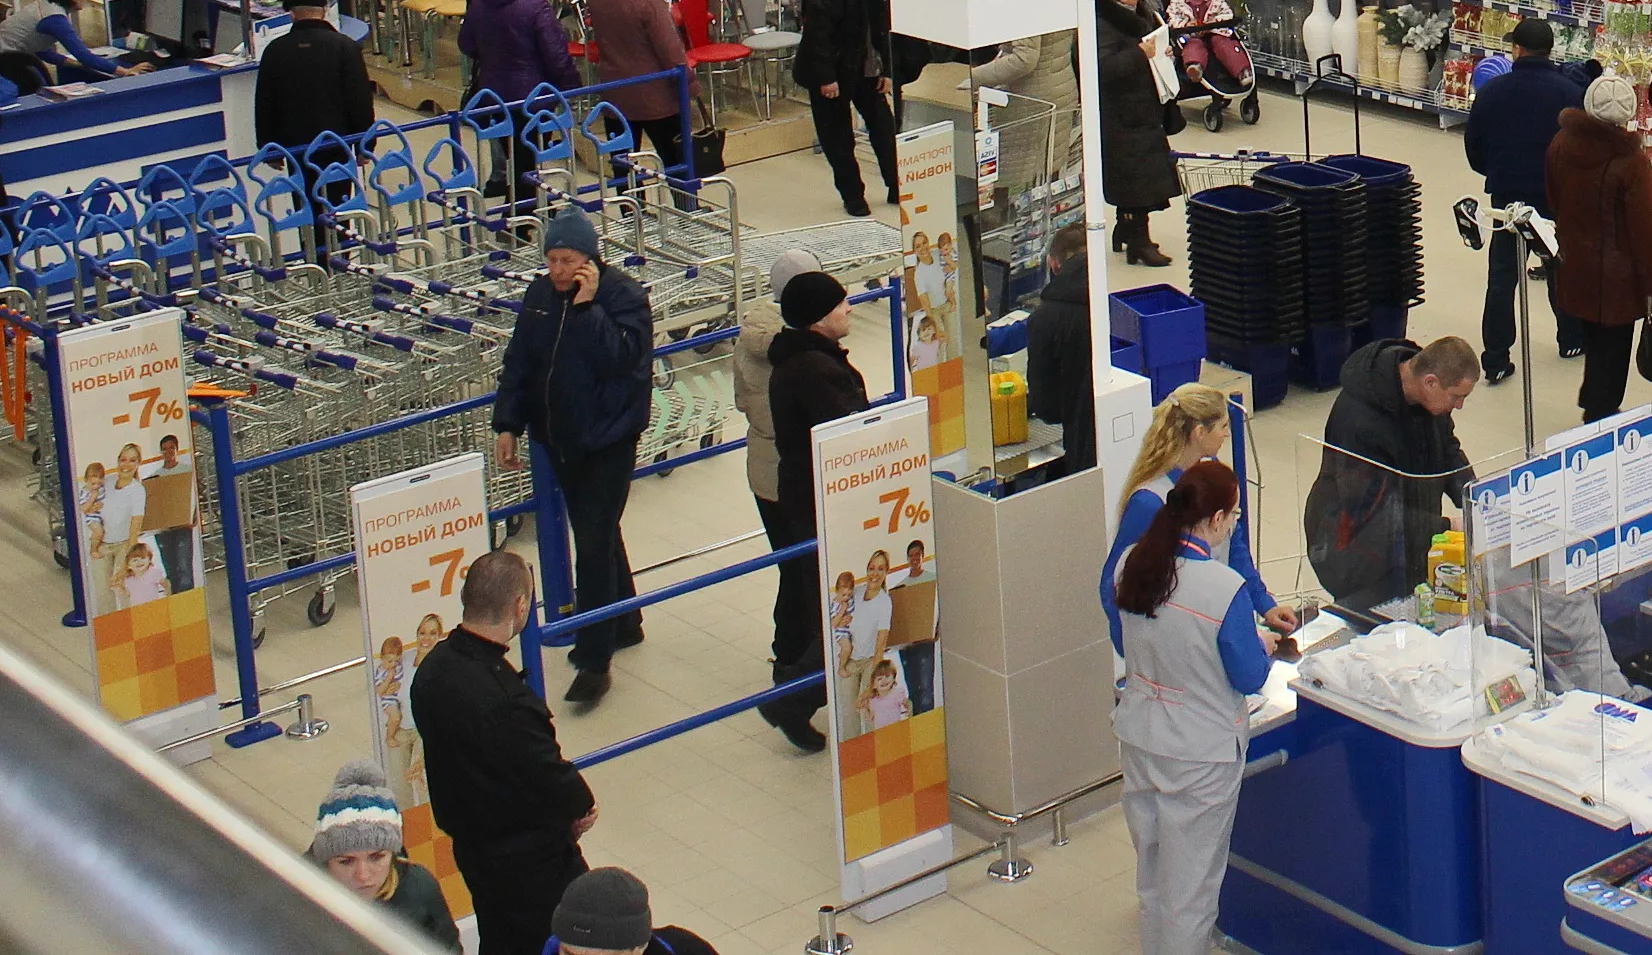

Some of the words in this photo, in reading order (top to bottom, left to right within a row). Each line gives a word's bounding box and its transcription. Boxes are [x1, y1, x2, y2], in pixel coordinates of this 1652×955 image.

[69, 342, 159, 372] ПРОГРАММА
[71, 365, 135, 393] НОВЫЙ
[139, 357, 179, 379] ДОМ
[112, 387, 184, 429] -7%
[825, 438, 909, 472] ПРОГРАММА
[826, 464, 886, 495] НОВЫЙ
[890, 454, 928, 479] ДОМ
[365, 497, 462, 534] ПРОГРАММА
[863, 487, 931, 535] -7%
[367, 524, 436, 558] НОВЫЙ
[441, 512, 484, 539] ДОМ
[411, 547, 469, 597] -7
